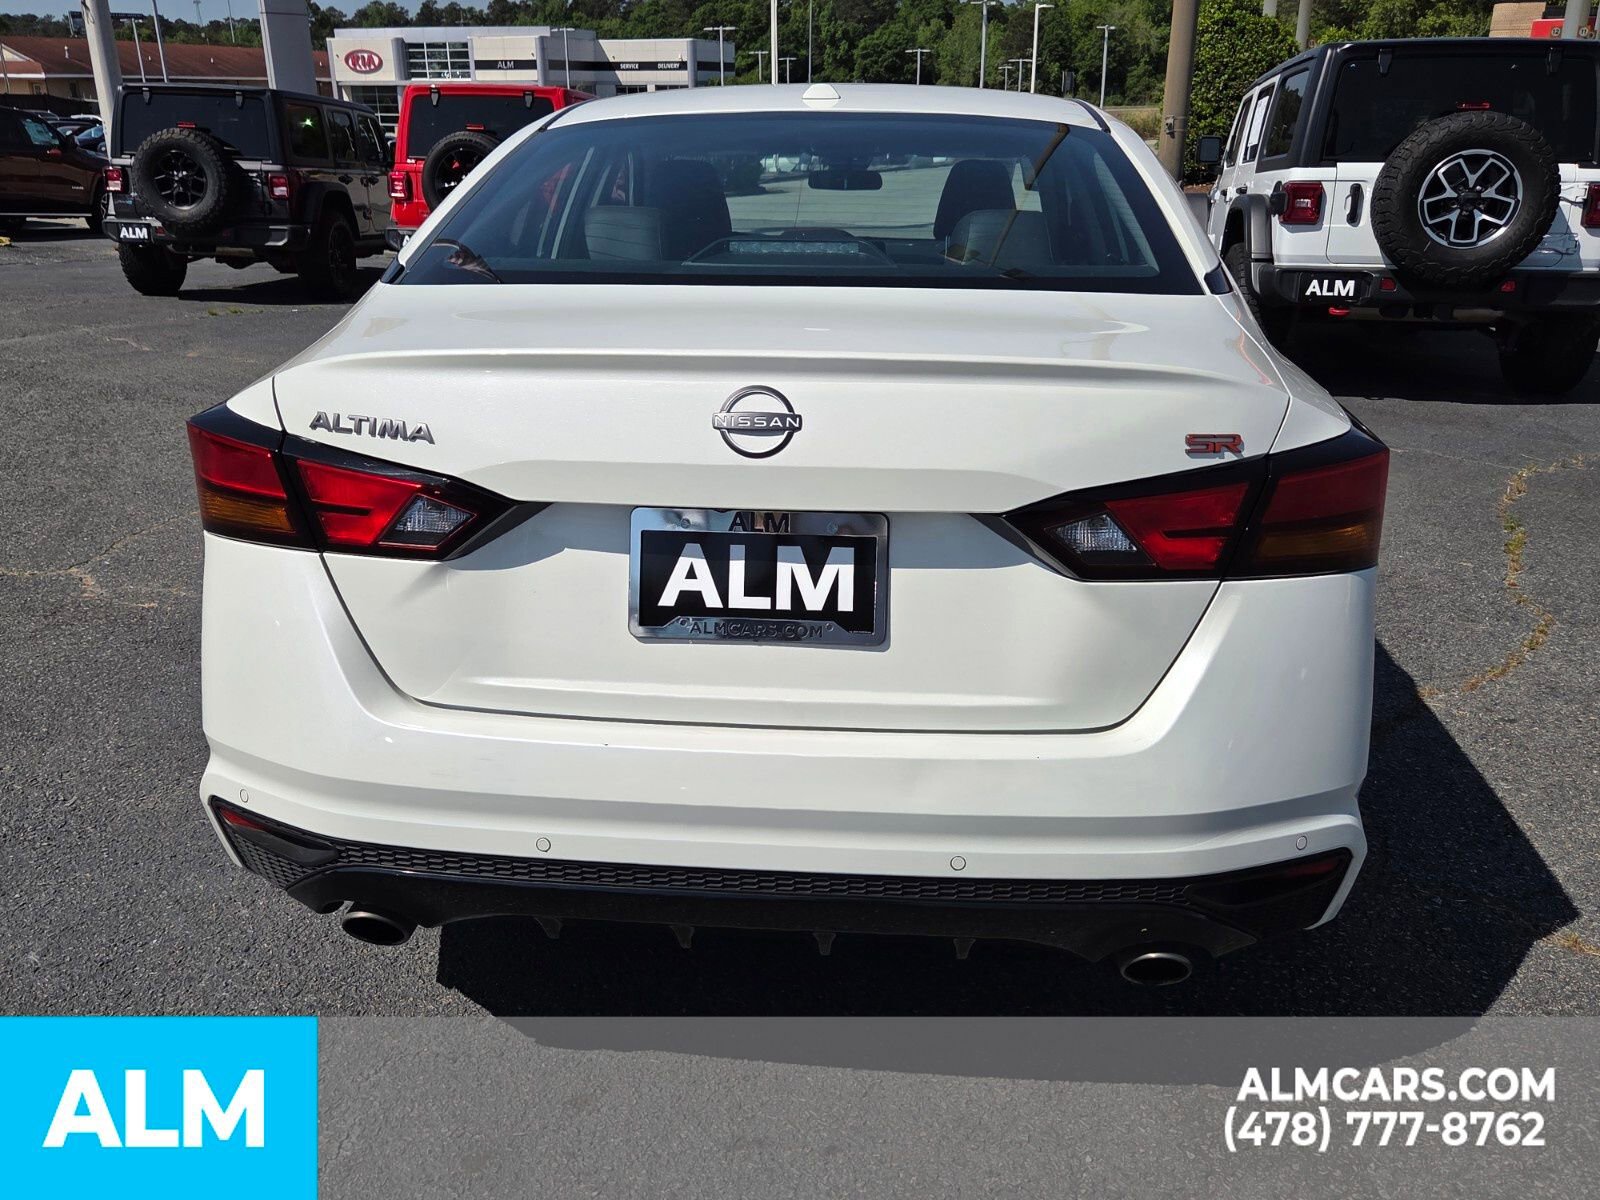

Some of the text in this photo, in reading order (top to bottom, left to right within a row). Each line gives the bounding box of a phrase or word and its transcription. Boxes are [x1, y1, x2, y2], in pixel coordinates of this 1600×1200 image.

[347, 51, 381, 72] KIA
[497, 60, 515, 69] ALM
[120, 226, 149, 239] ALM
[1305, 279, 1356, 298] ALM
[309, 410, 436, 445] ALTIMA
[714, 413, 802, 430] NISSAN
[1185, 433, 1242, 454] SR
[728, 512, 791, 533] ALM
[657, 542, 855, 612] ALM
[689, 616, 825, 639] ALMCARS.COM
